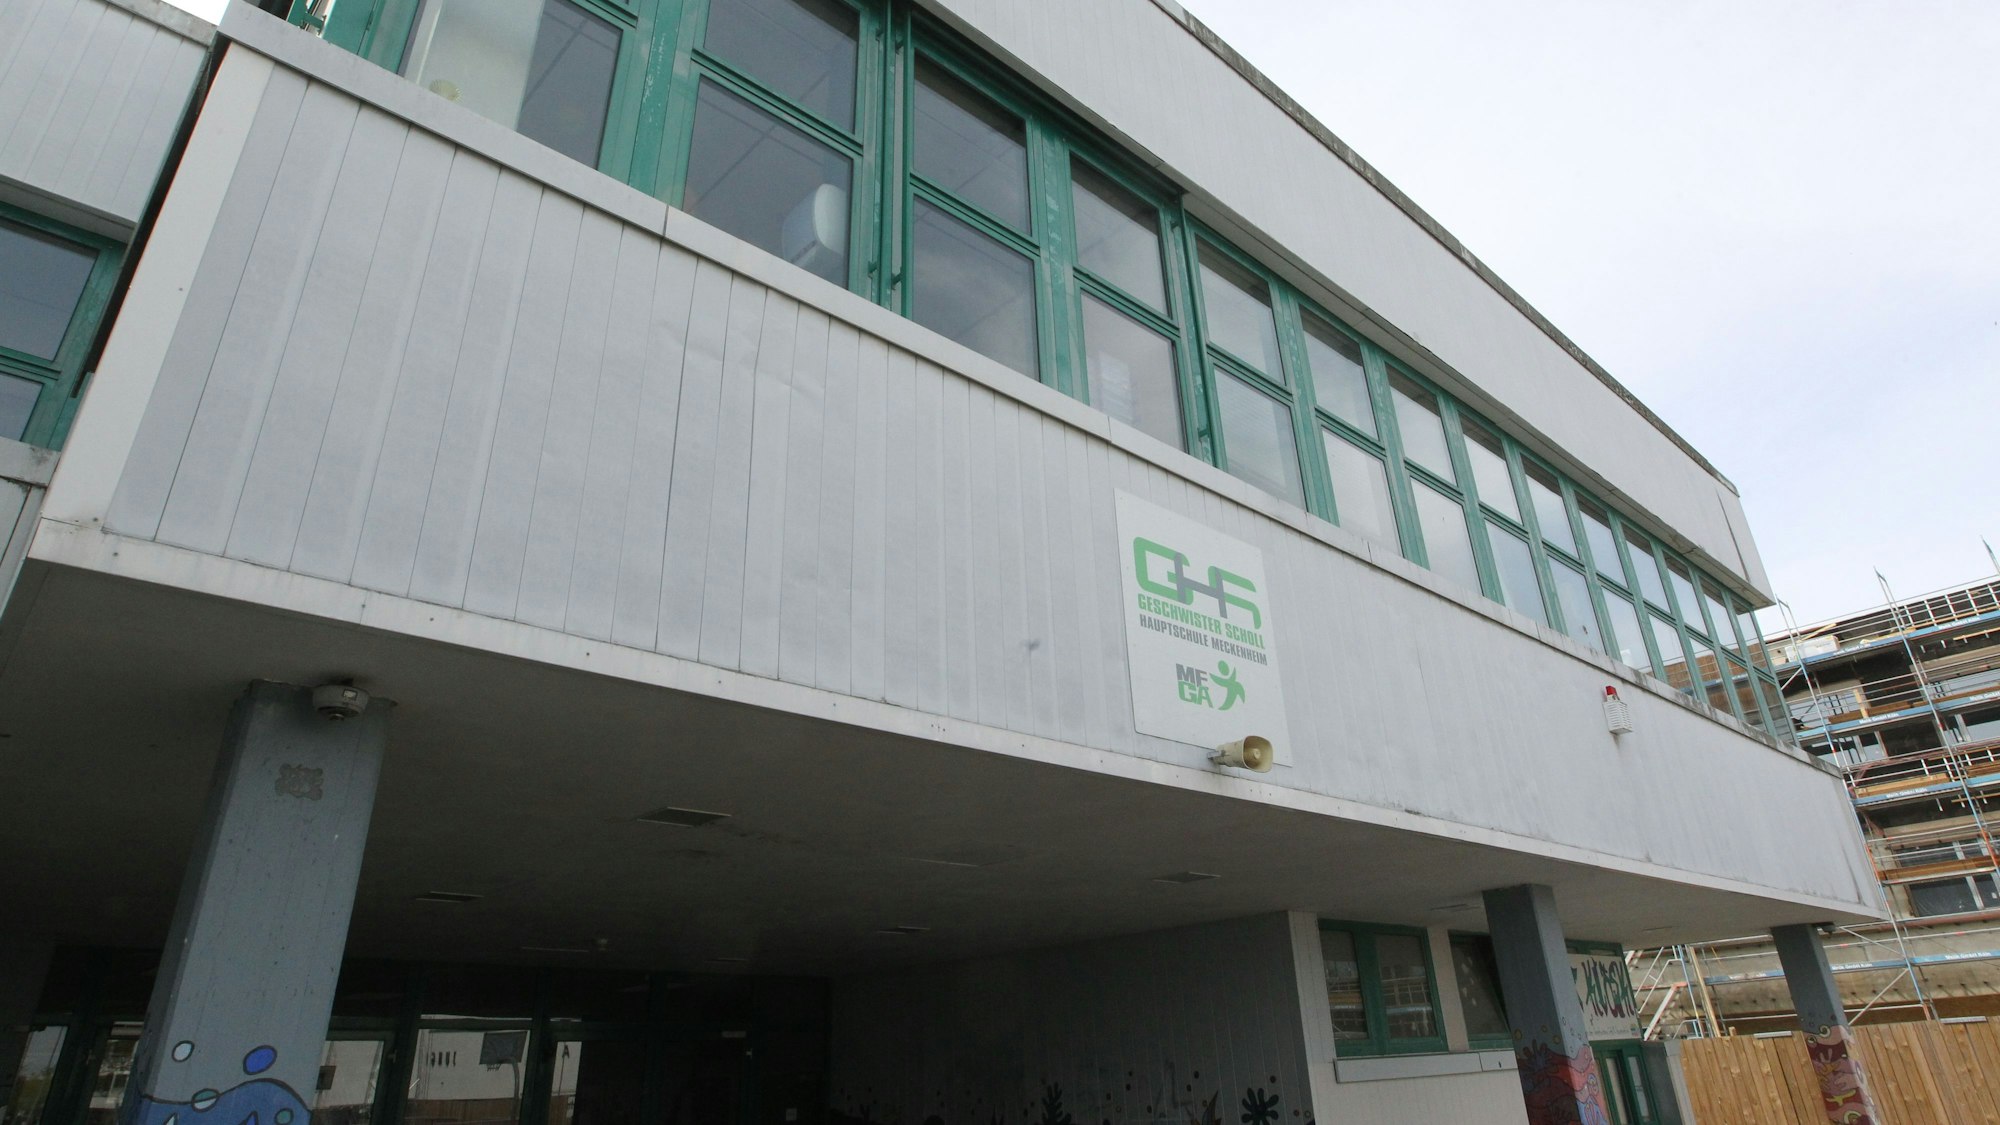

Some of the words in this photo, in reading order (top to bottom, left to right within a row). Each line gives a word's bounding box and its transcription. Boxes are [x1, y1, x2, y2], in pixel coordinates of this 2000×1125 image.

[1133, 537, 1262, 630] GHS
[1137, 593, 1222, 635] GESCHWISTER
[1224, 622, 1266, 650] SCHOLL
[1139, 613, 1209, 647] HAUPTSCHULE
[1210, 637, 1268, 666] MECKENHEIM
